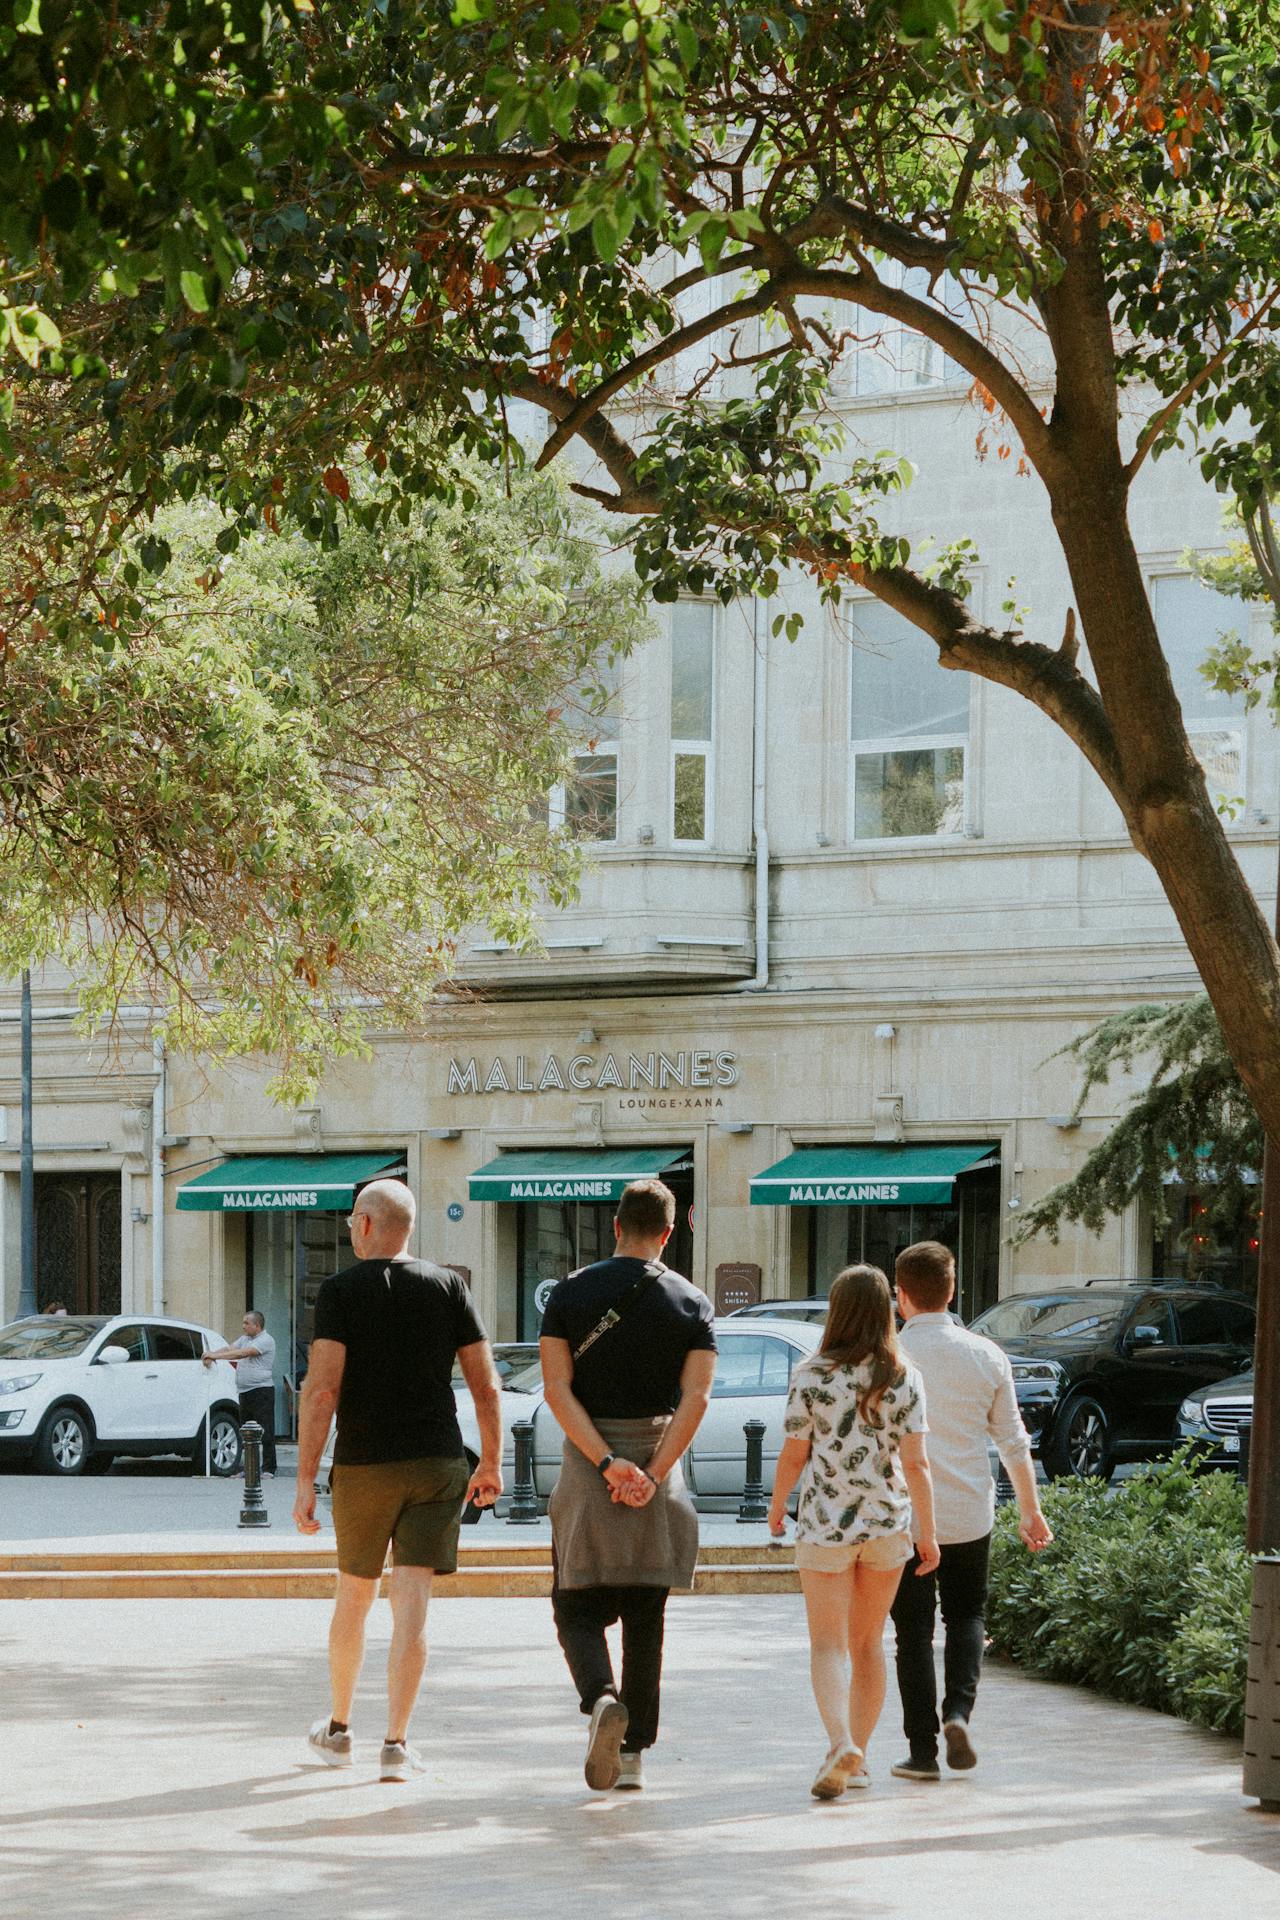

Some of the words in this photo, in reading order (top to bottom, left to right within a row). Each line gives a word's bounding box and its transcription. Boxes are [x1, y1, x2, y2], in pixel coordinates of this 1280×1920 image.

[447, 1051, 738, 1093] MALACANNES
[510, 1182, 612, 1197] MALACANNES
[789, 1185, 899, 1200] MALACANNES
[223, 1192, 318, 1207] MALACANNES
